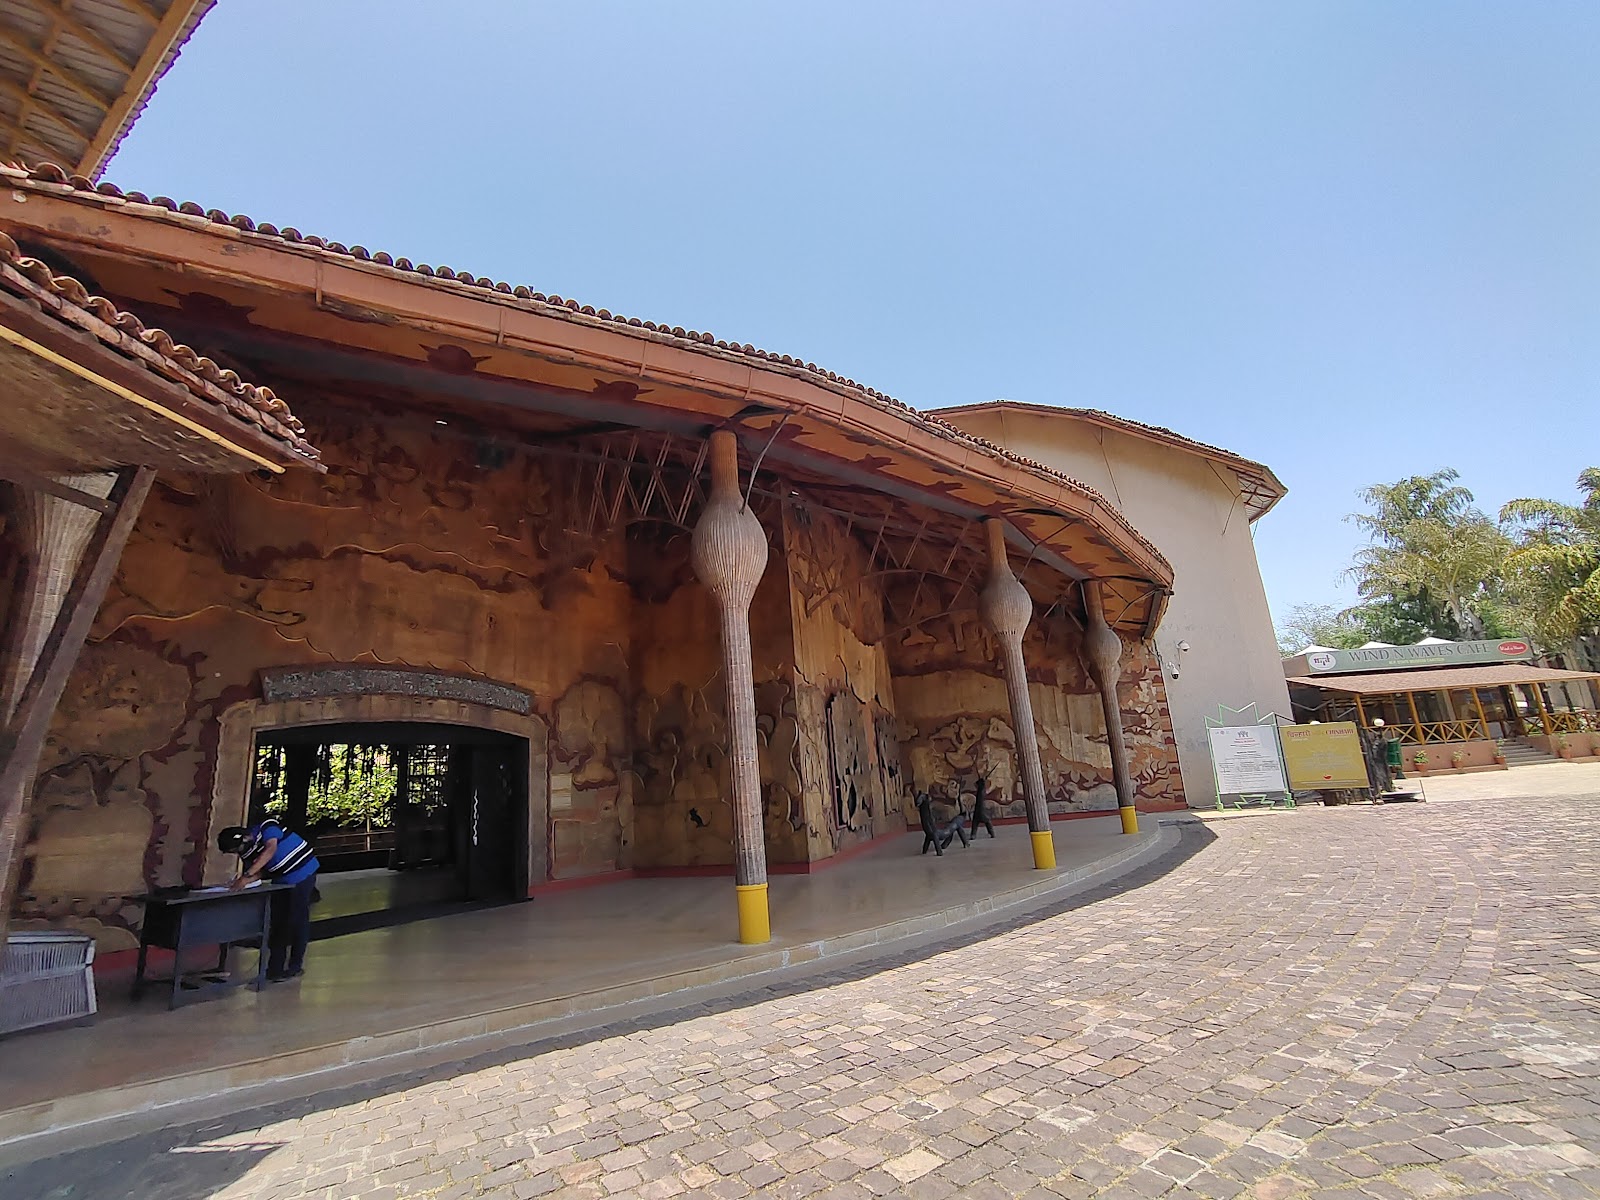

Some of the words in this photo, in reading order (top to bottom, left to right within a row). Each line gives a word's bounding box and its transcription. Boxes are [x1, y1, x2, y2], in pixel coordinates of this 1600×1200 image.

[1348, 648, 1390, 662] WIND
[1392, 647, 1404, 659] N
[1407, 644, 1454, 658] WAVES
[1456, 643, 1491, 655] CAFE
